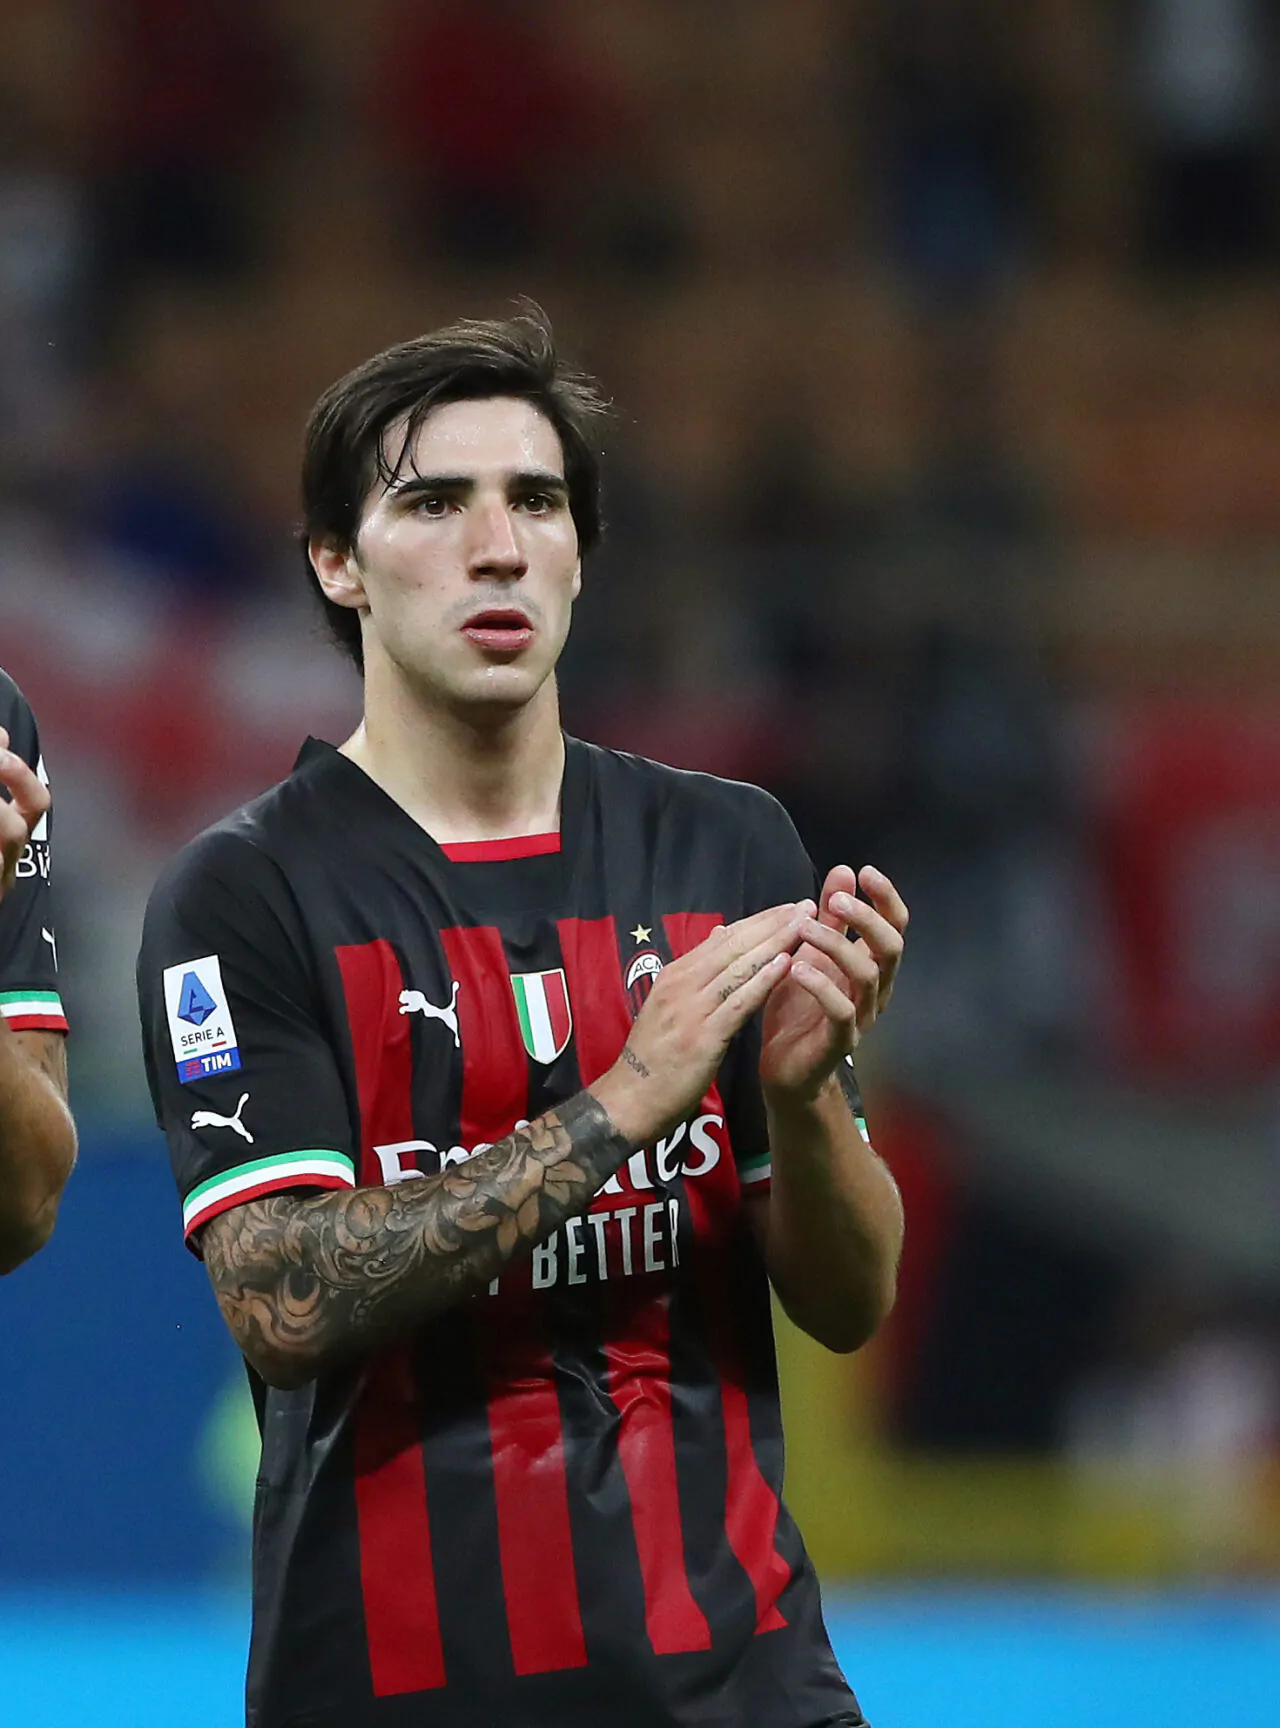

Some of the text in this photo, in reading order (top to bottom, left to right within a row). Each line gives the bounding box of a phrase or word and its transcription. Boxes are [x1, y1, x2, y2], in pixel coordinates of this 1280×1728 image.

[180, 1026, 225, 1047] SERIE A
[201, 1052, 233, 1073] TIM
[531, 1198, 680, 1290] BETTER
